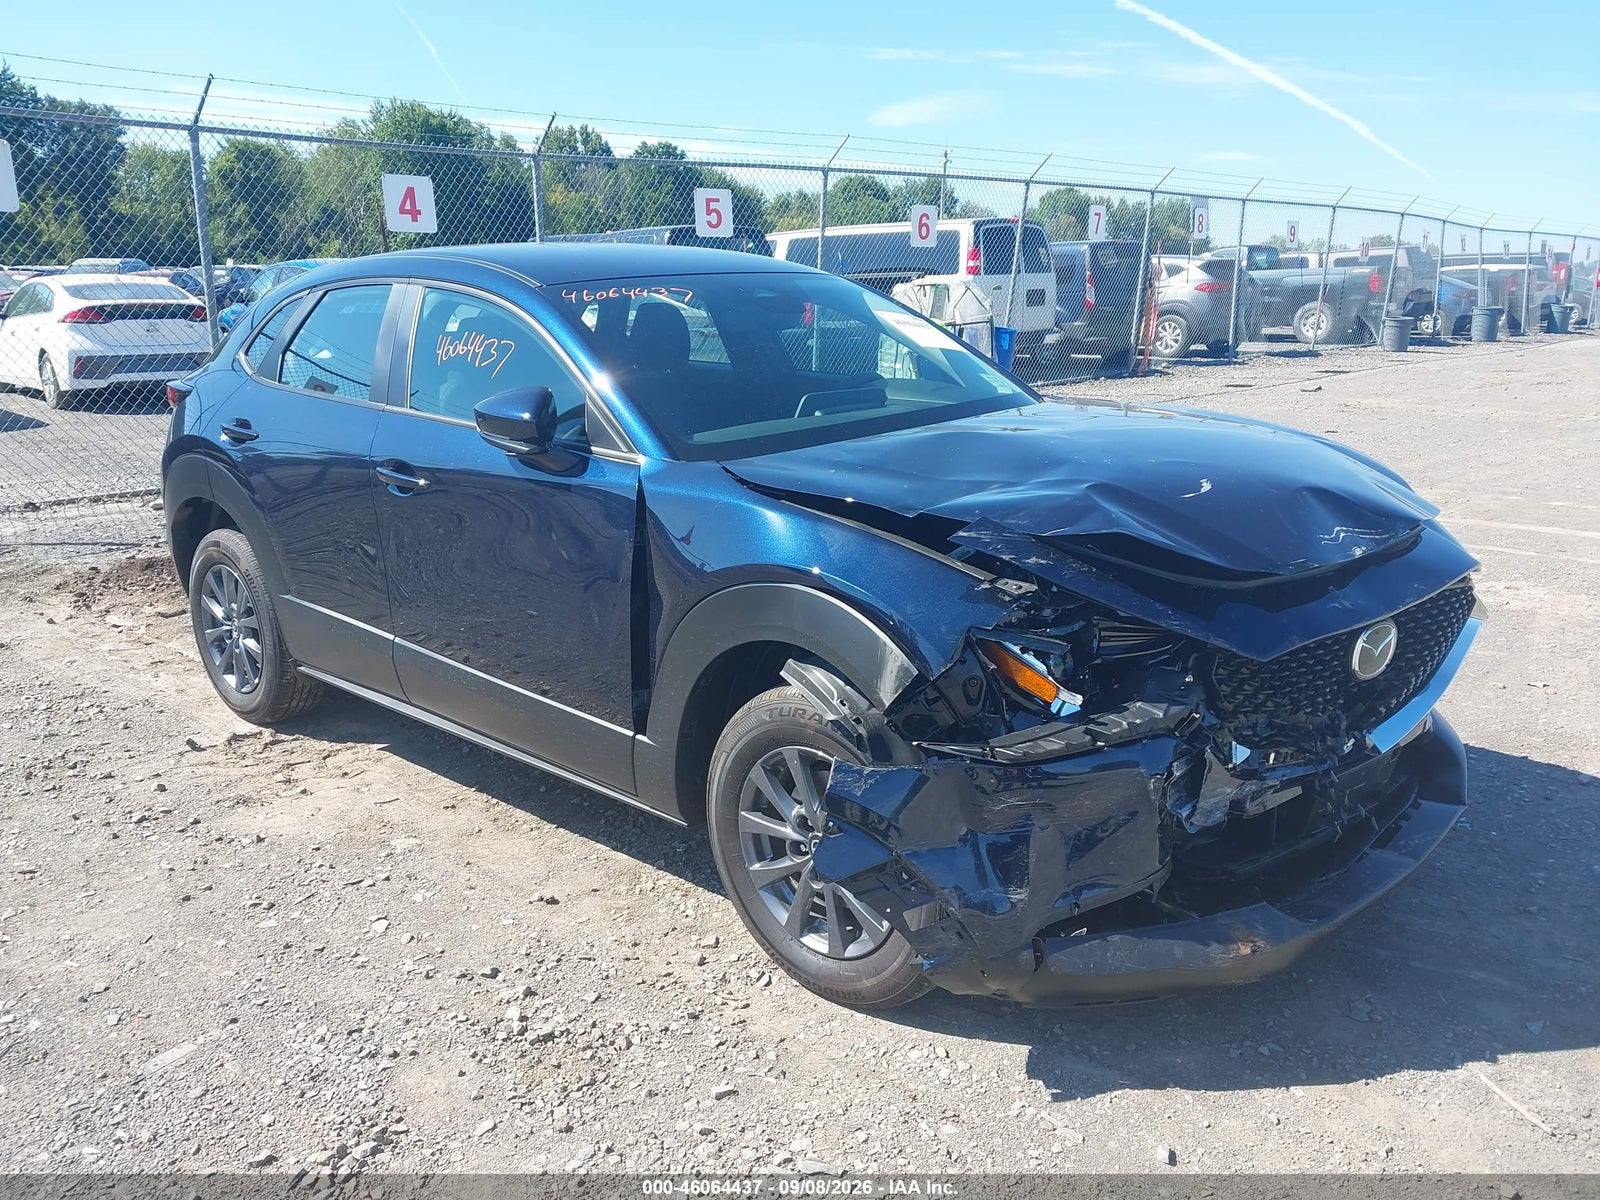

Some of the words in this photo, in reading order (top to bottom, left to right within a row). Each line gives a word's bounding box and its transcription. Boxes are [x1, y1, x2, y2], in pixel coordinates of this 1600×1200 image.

[398, 186, 422, 223] 4
[705, 197, 723, 229] 5
[917, 212, 931, 241] 6
[1094, 212, 1102, 235] 7
[1197, 213, 1204, 233] 8
[1289, 225, 1296, 243] 9
[1361, 242, 1370, 257] 10
[562, 286, 693, 304] 46064437
[436, 331, 515, 379] 46064437
[765, 706, 832, 728] TURA
